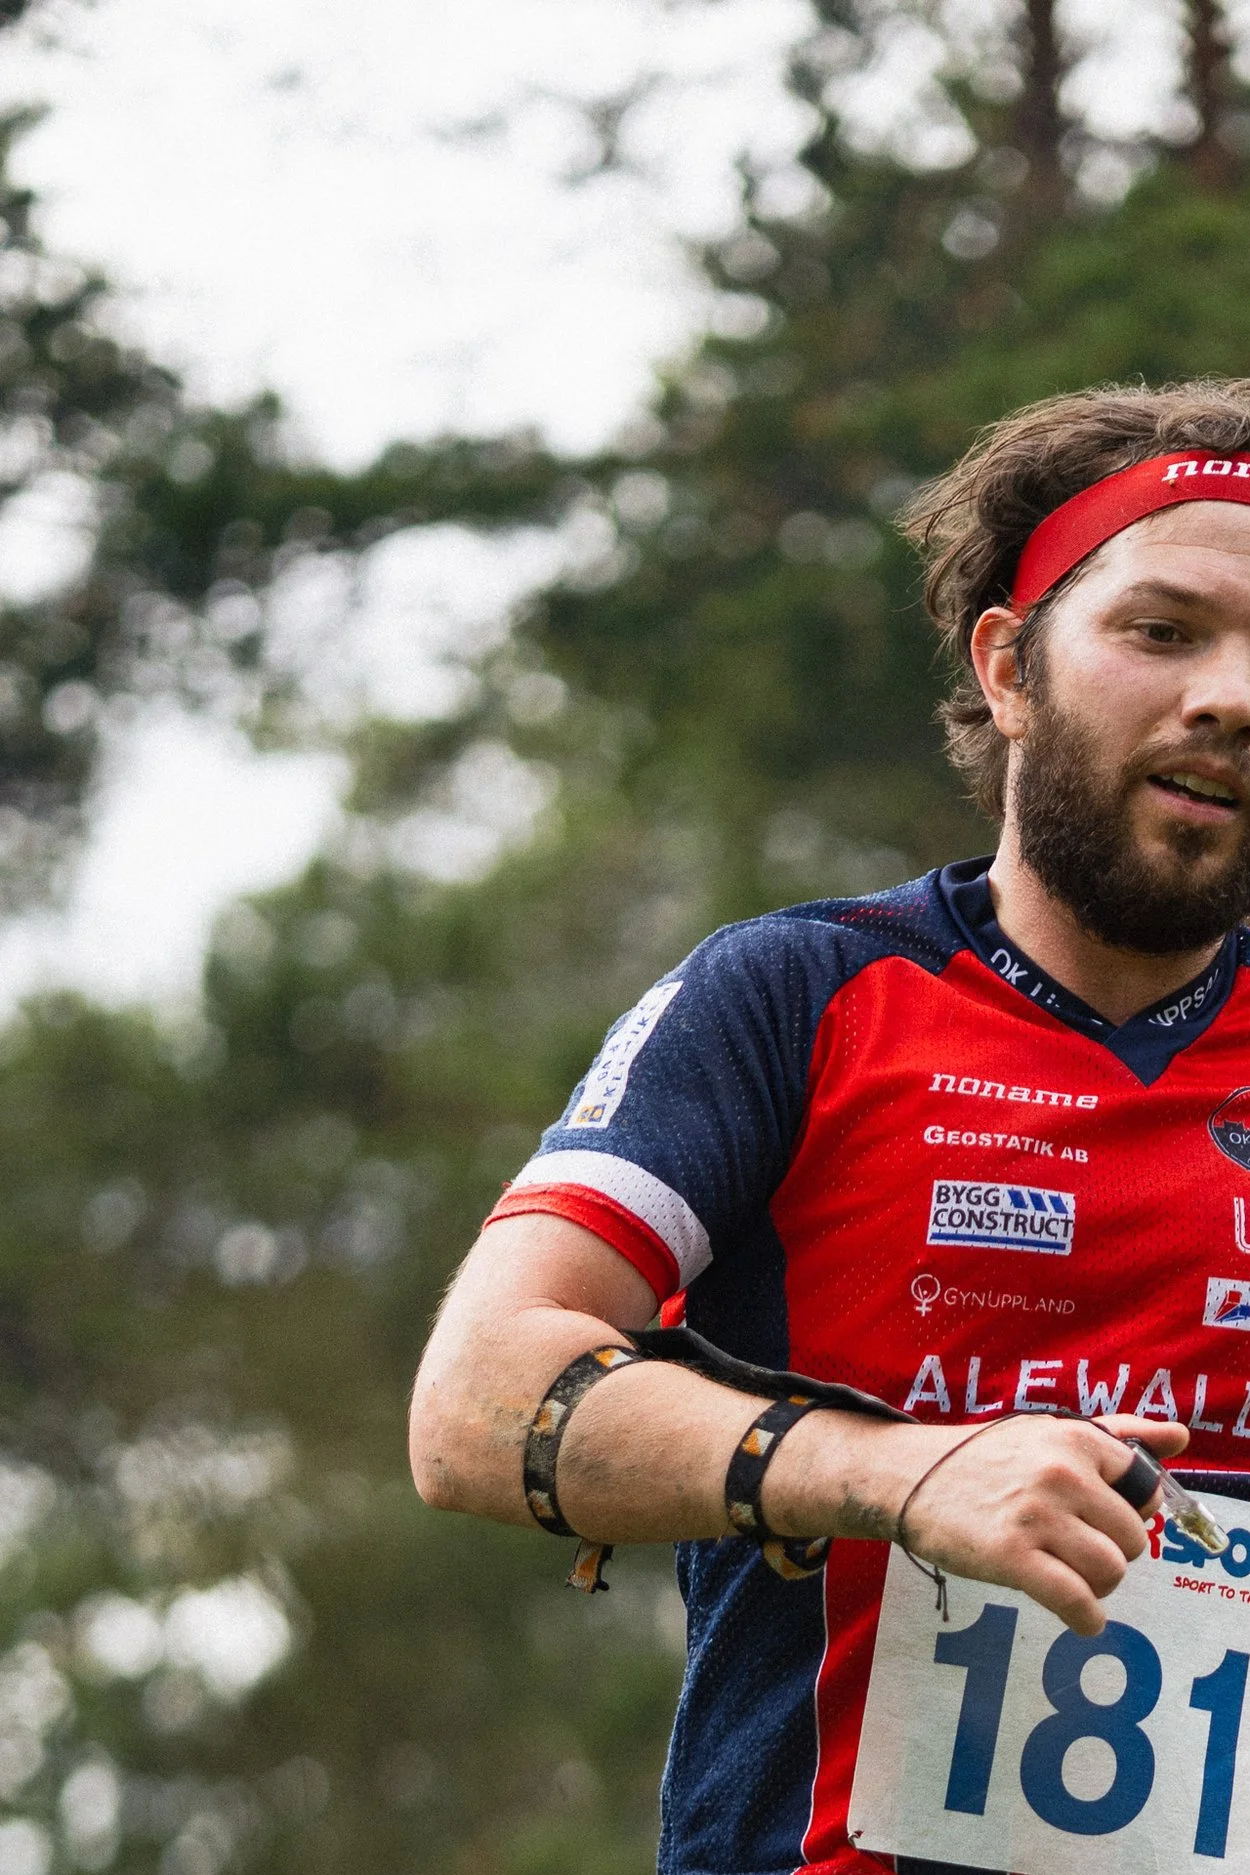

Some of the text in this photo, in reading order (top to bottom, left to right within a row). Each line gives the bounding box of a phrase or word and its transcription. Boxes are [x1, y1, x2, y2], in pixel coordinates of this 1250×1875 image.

[928, 1073, 1099, 1109] noname
[1061, 1145, 1089, 1163] AB
[936, 1184, 1001, 1207] BYGG
[932, 1208, 1074, 1238] CONSTRUCT
[1173, 1575, 1216, 1594] SPORT
[1218, 1585, 1236, 1599] TO
[933, 1602, 1250, 1859] 181
